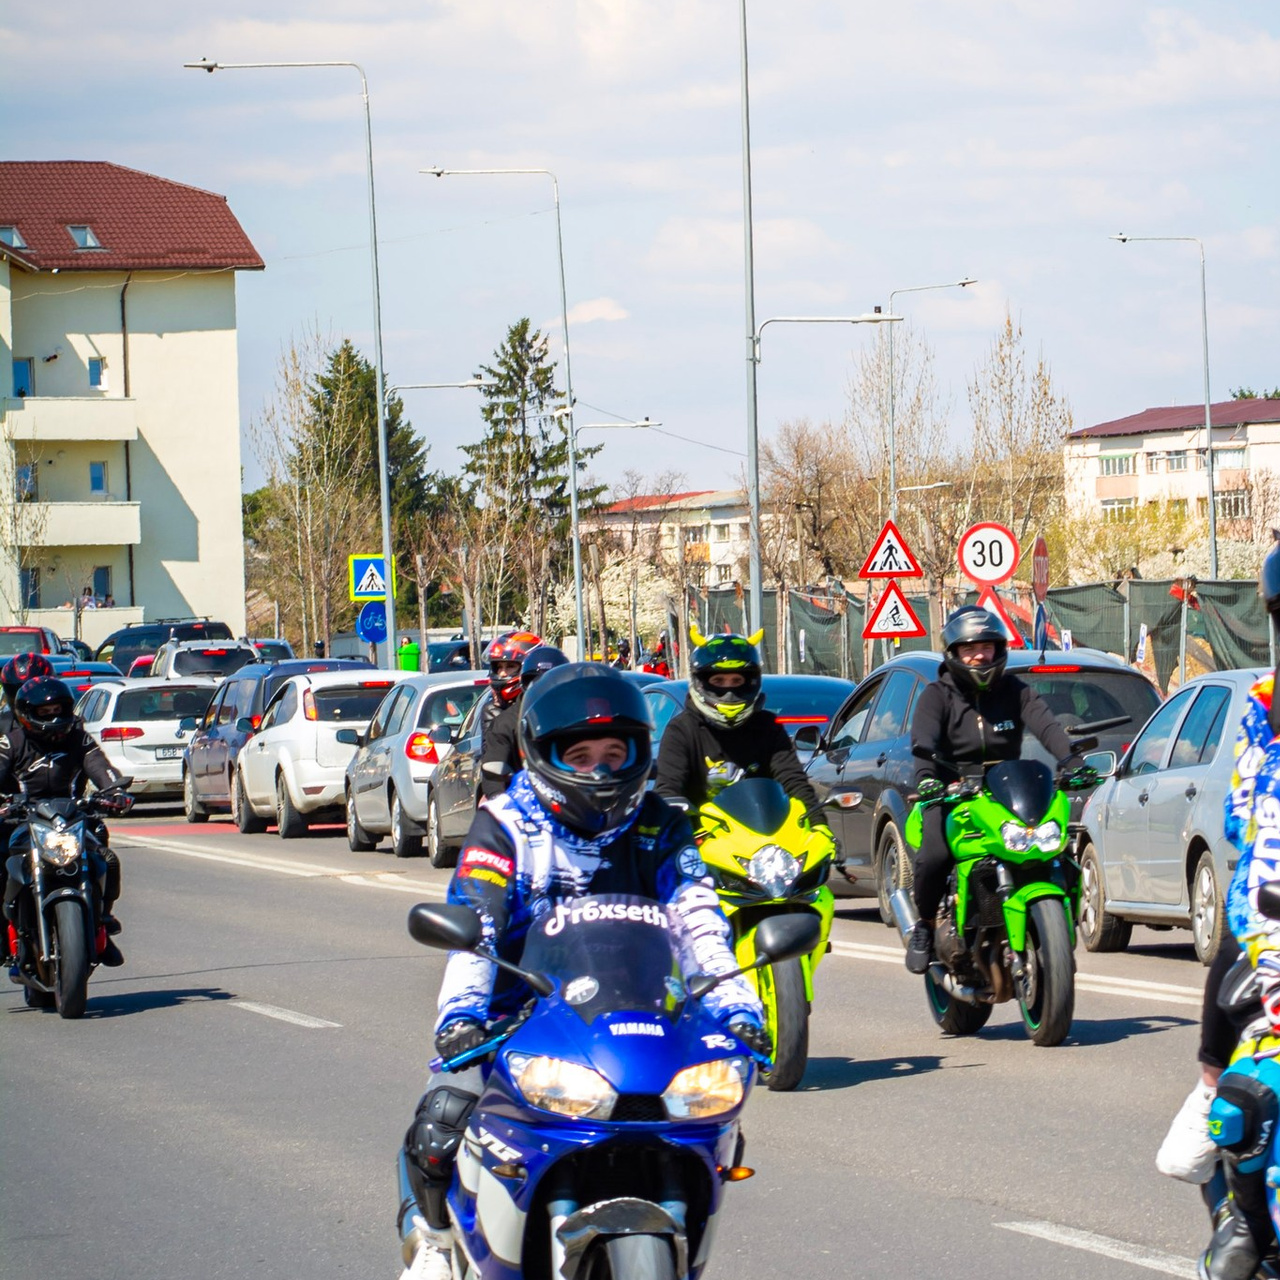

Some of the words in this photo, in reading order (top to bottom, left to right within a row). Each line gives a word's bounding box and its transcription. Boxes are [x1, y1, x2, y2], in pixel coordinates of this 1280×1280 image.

[972, 540, 1003, 567] 30
[571, 900, 668, 929] r6xseth
[609, 1022, 665, 1037] YAMAHA
[701, 1034, 737, 1051] R6
